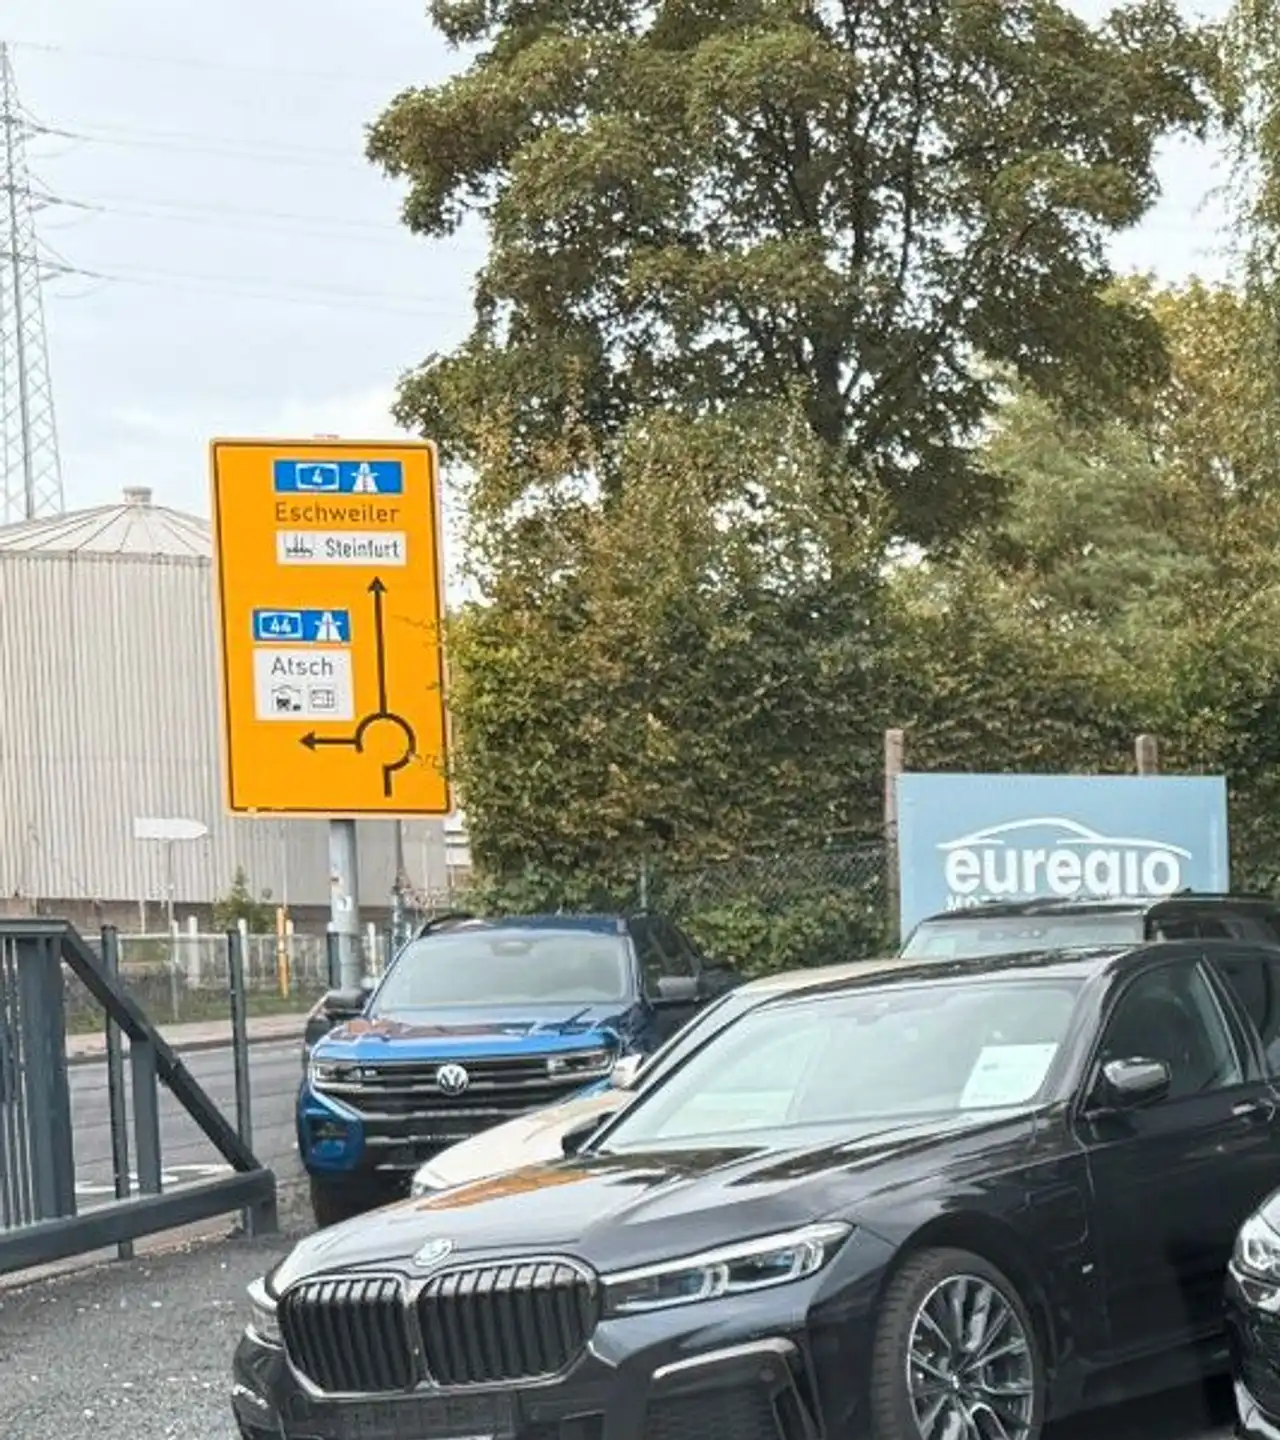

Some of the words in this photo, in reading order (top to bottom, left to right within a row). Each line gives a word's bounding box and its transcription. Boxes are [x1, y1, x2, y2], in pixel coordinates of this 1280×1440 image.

[275, 501, 400, 523] Eschweiler
[325, 537, 400, 558] Steinfurt
[271, 656, 334, 677] Atsch
